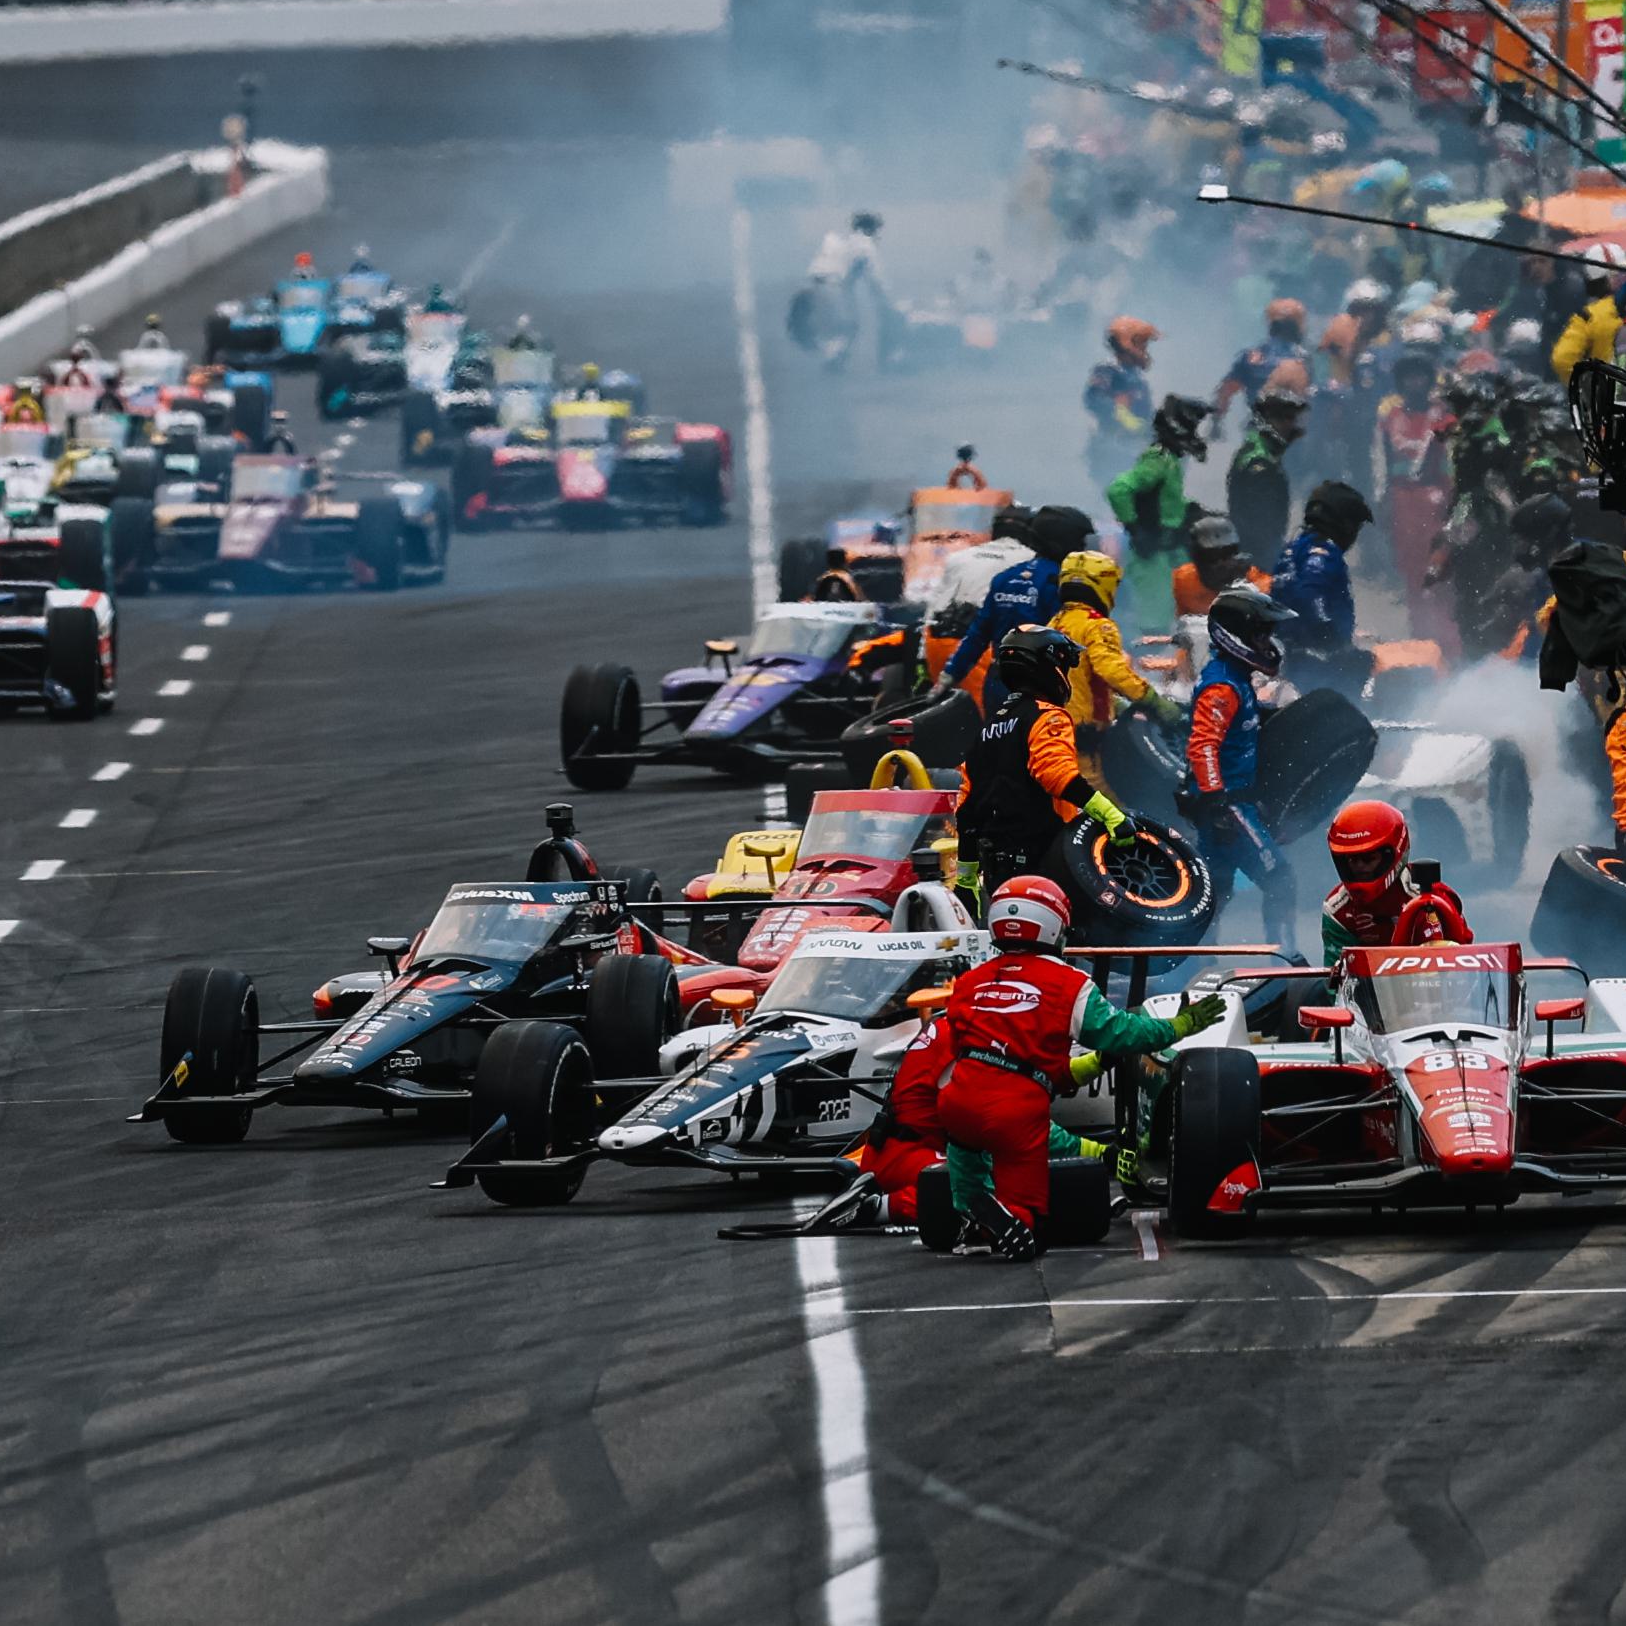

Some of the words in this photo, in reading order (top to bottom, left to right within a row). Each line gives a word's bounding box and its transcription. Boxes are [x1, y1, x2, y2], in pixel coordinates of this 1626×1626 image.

[1073, 817, 1095, 846] Fires
[552, 890, 591, 905] Spectrum
[877, 940, 909, 952] LUCAS
[910, 939, 926, 951] OIL
[1396, 953, 1504, 972] PILOTI
[974, 990, 1040, 1003] PREMA
[1424, 1052, 1489, 1072] 83
